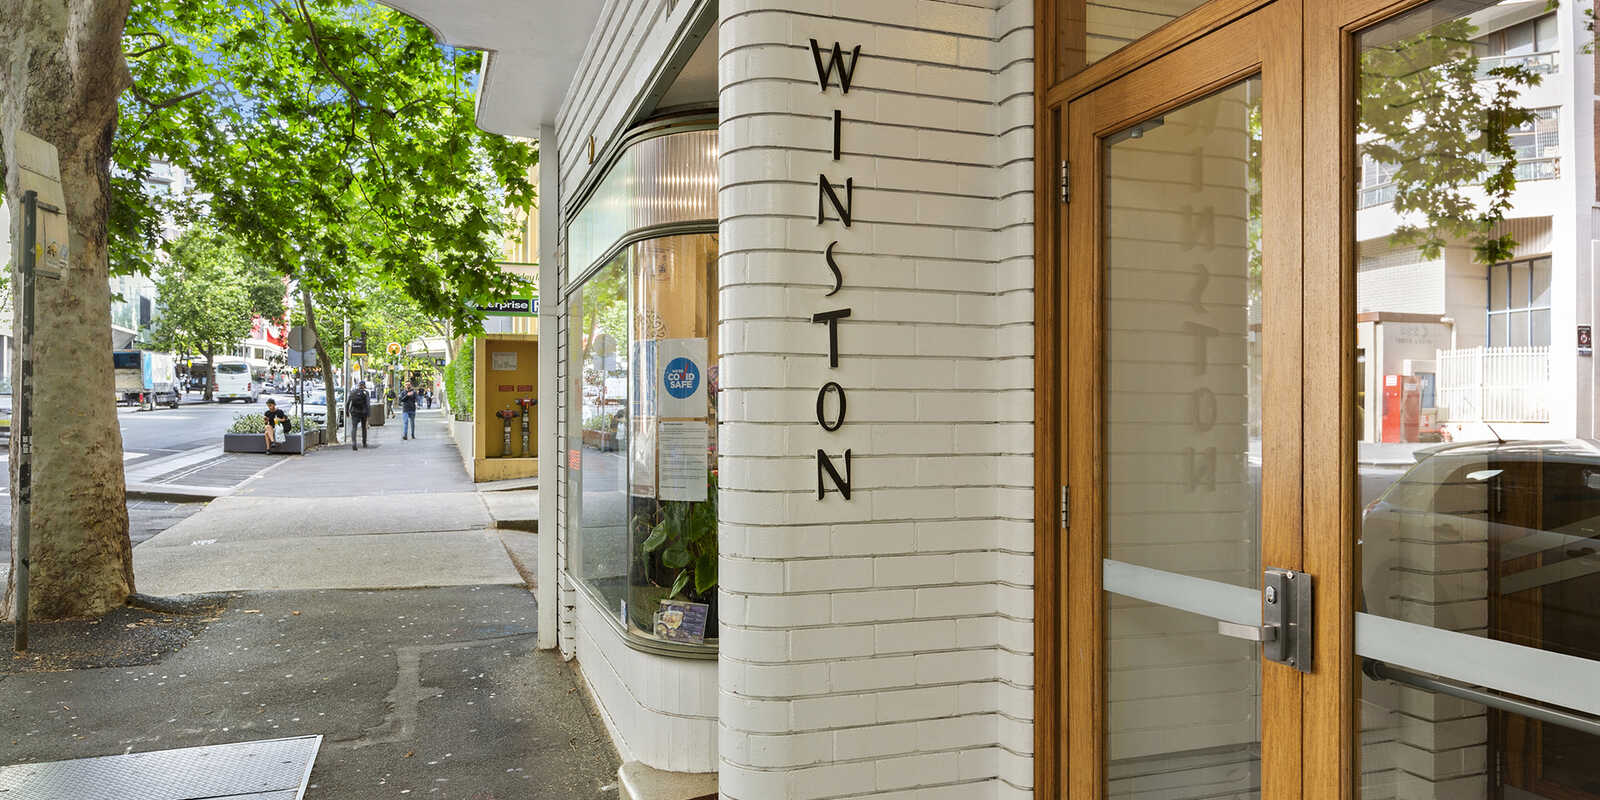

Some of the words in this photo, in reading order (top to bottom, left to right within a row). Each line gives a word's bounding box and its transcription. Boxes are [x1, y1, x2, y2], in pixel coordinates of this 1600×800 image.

[809, 38, 862, 501] WINSTON
[466, 300, 529, 310] erprise
[668, 367, 695, 381] COVID
[670, 380, 693, 389] SAFE
